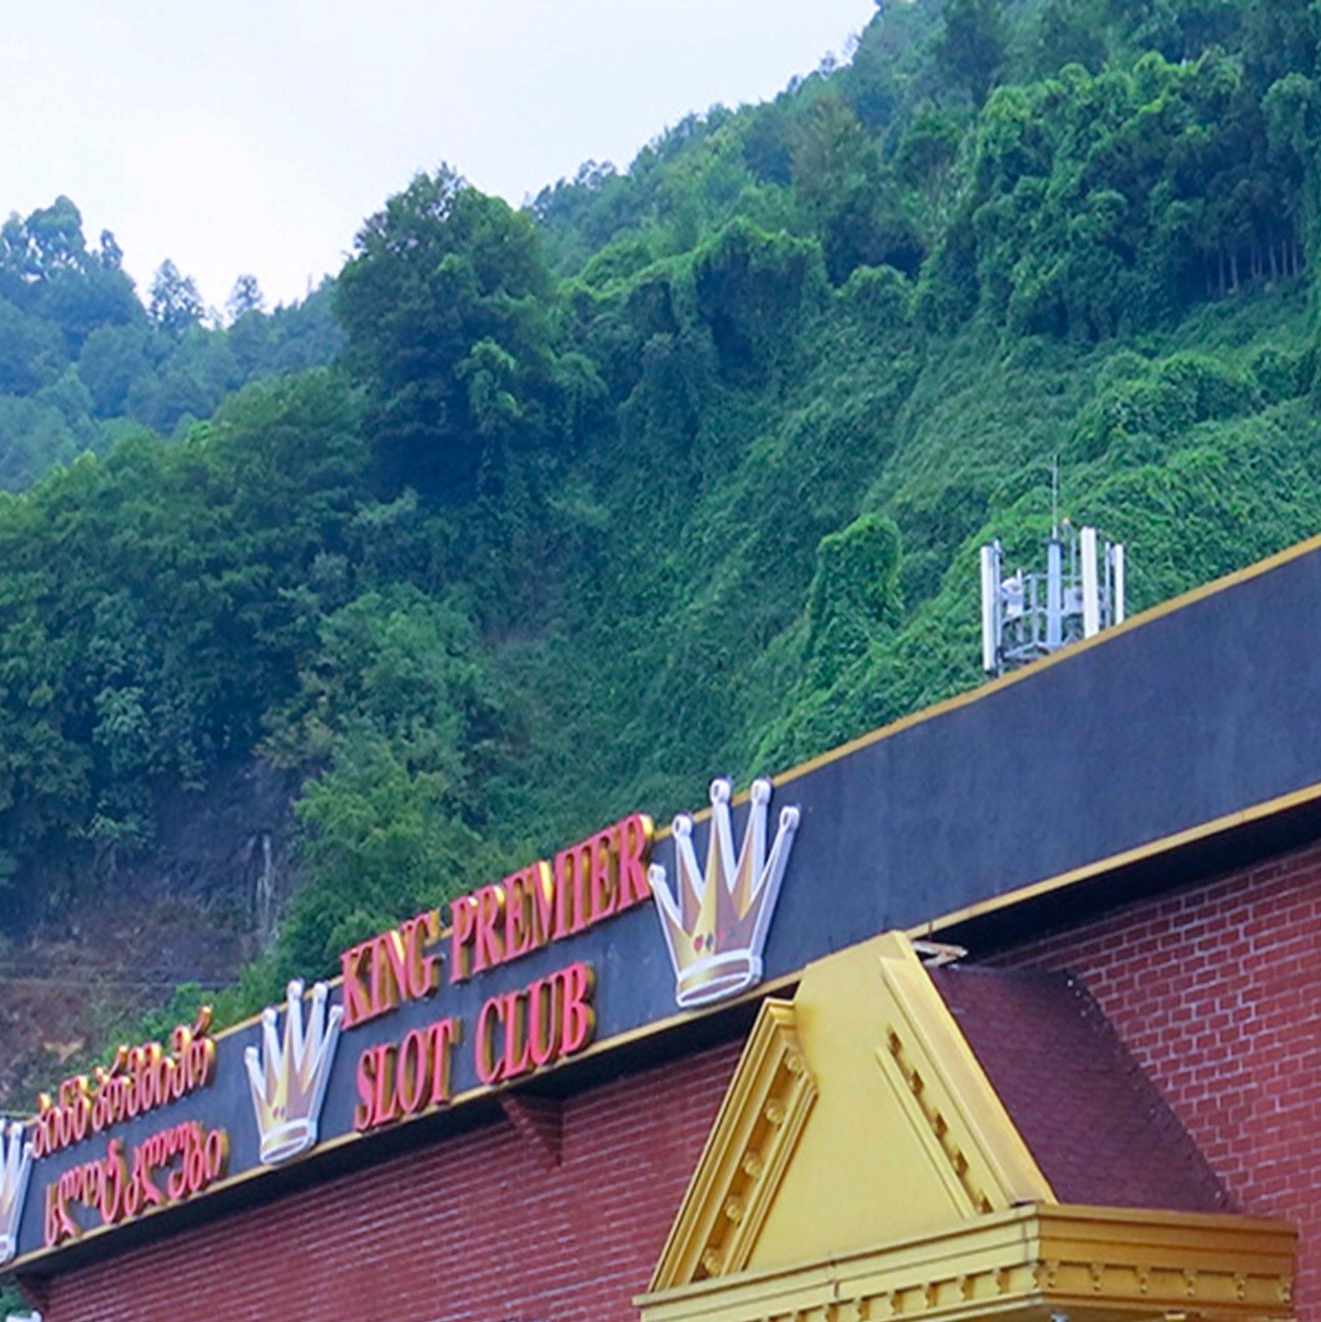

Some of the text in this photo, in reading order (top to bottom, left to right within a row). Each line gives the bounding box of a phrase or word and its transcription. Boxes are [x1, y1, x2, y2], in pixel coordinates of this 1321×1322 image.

[339, 813, 654, 1031] KING PREMIER
[355, 961, 595, 1132] SLOT CLUB
